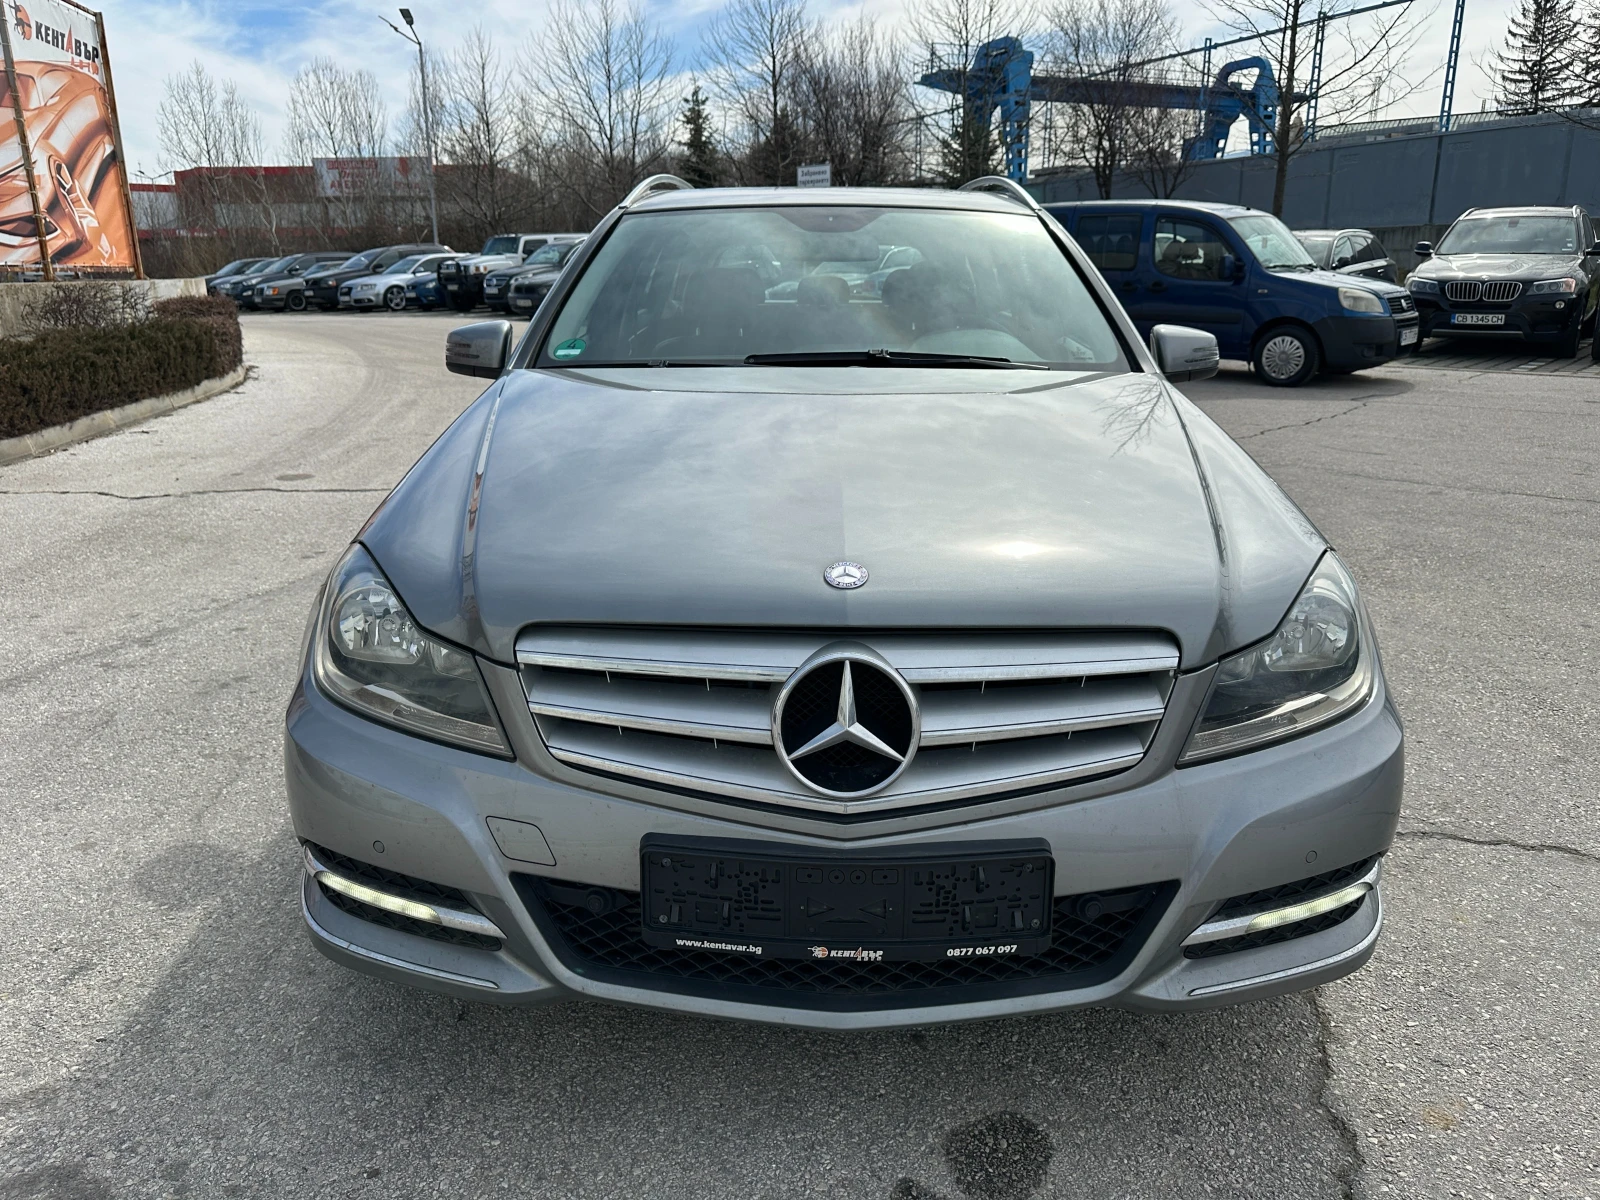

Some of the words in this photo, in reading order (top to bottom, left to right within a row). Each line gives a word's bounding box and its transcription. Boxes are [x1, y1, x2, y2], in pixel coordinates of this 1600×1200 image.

[34, 20, 99, 63] КЕНТАВЪР
[1470, 315, 1490, 324] 1345
[676, 939, 762, 955] www.kentavar.bg
[947, 948, 973, 957] 0877
[975, 946, 995, 955] 067
[997, 944, 1018, 954] 097
